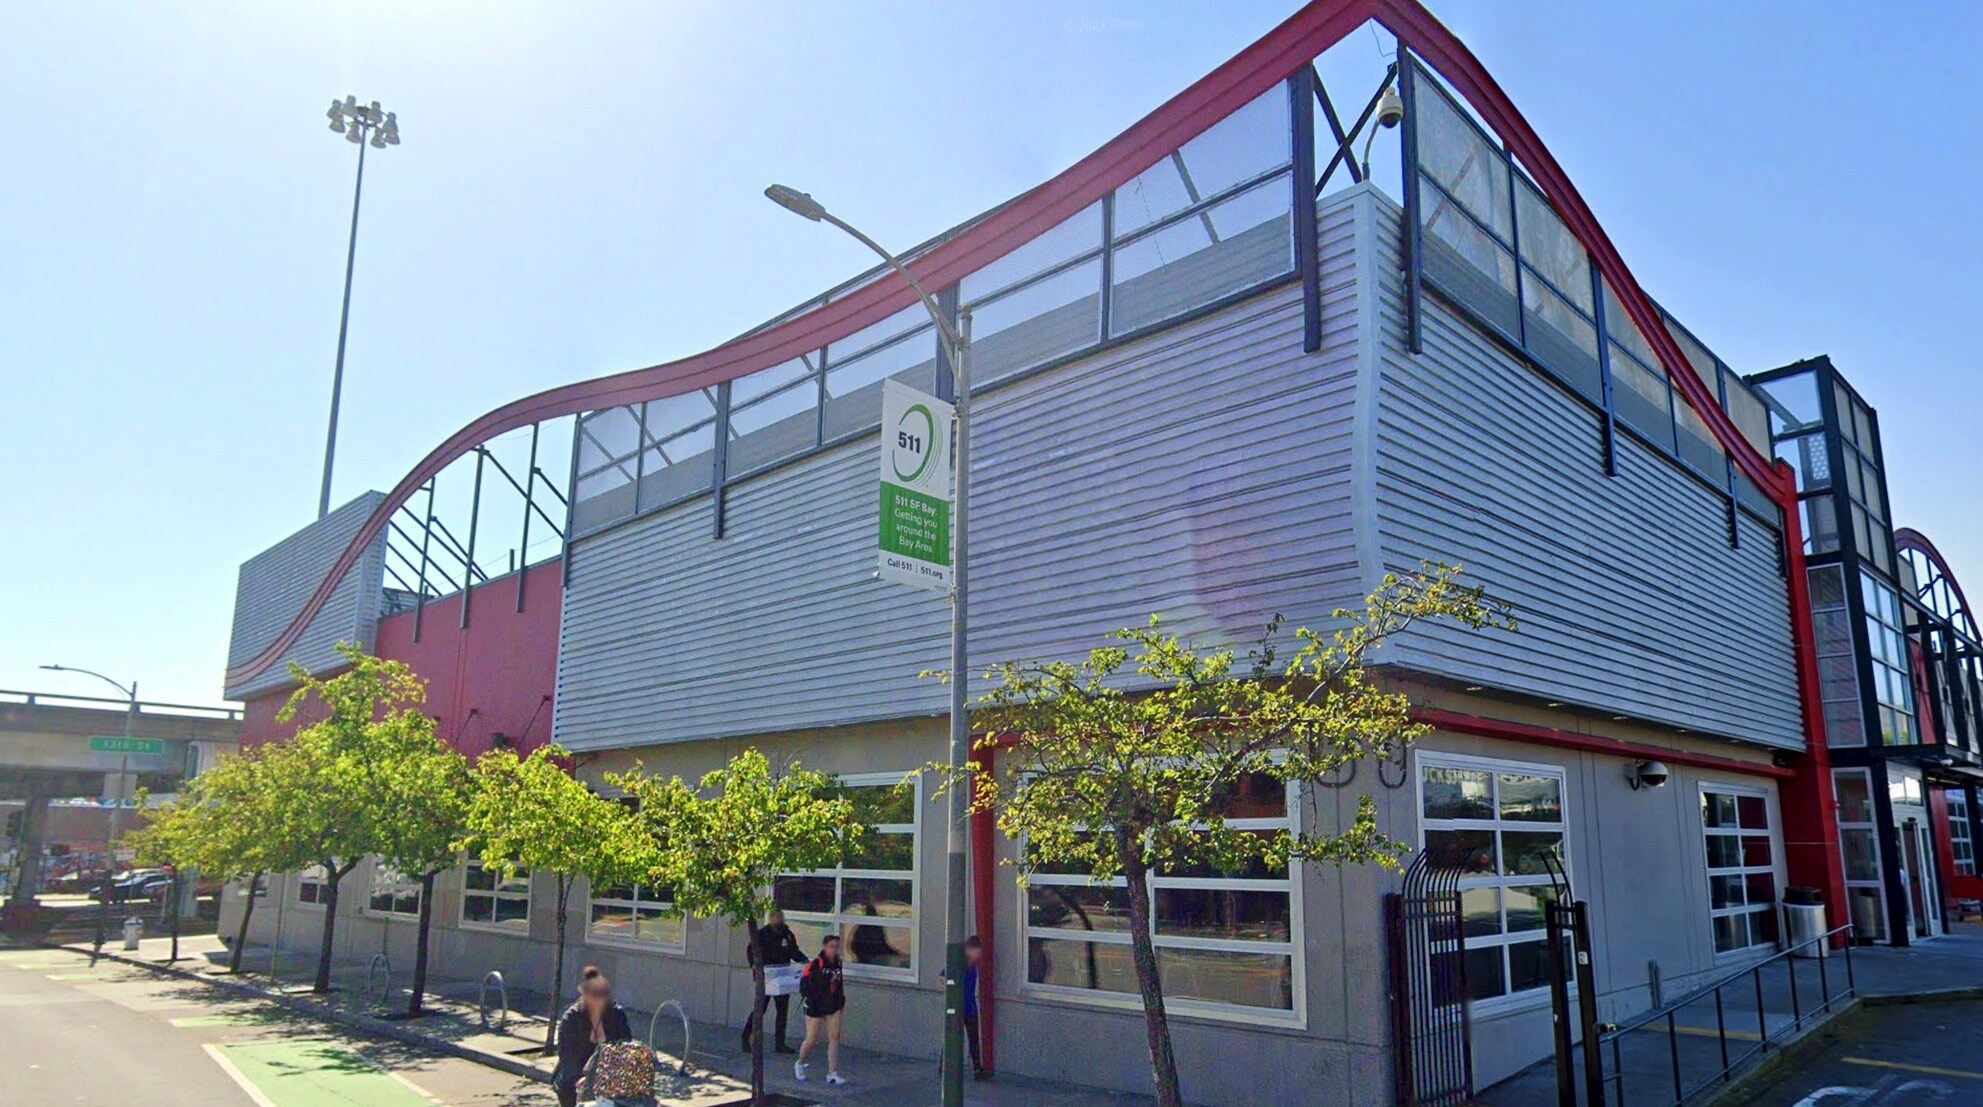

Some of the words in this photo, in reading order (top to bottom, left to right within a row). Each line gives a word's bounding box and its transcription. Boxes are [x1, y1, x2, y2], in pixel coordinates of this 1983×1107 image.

[898, 431, 921, 453] 511
[895, 495, 908, 507] 511
[910, 499, 920, 510] SF
[895, 508, 922, 526] Getting
[923, 518, 938, 528] you
[896, 523, 923, 537] around
[924, 530, 937, 541] the
[899, 535, 914, 550] Bay
[915, 540, 932, 552] Area
[887, 558, 900, 568] Call
[901, 562, 912, 571] 511
[920, 566, 943, 580] 511.org
